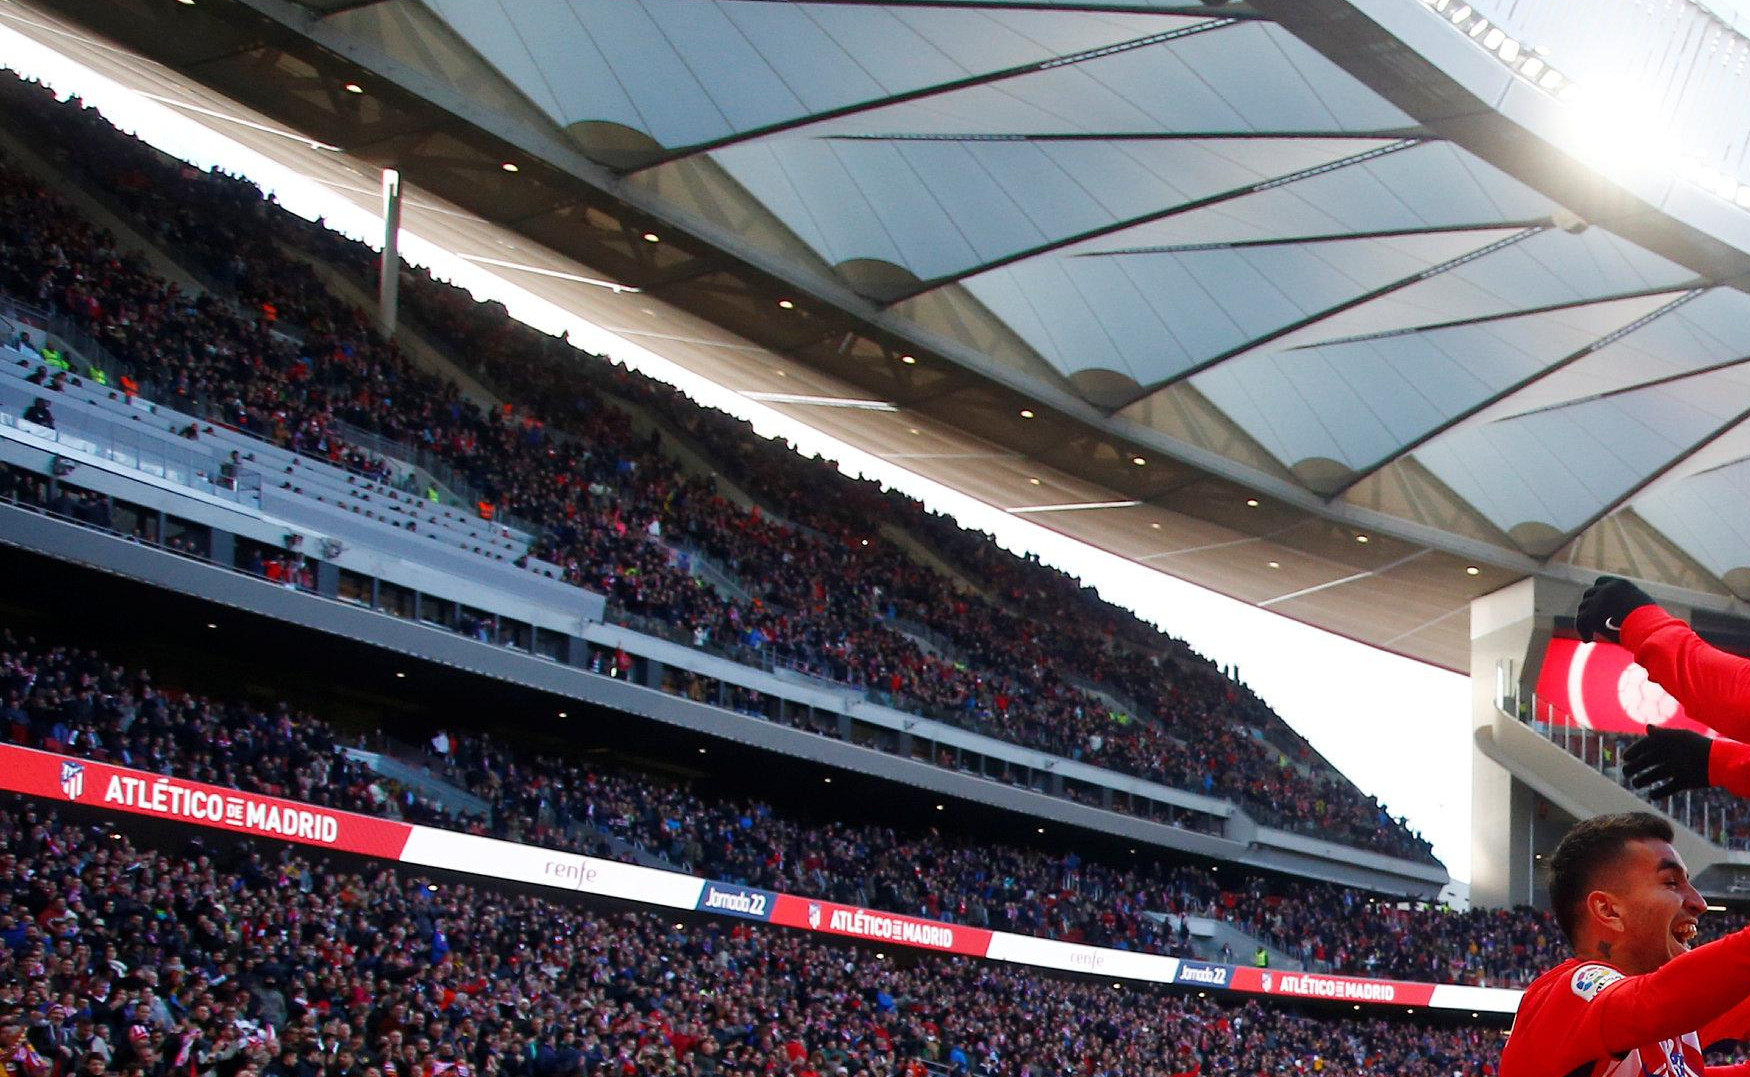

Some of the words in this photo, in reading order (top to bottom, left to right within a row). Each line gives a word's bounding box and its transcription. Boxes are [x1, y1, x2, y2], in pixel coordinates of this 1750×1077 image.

[104, 774, 224, 822] ATLÉTICO
[246, 800, 339, 843] MADRID
[545, 860, 598, 890] renfe
[705, 887, 751, 913] Jornada
[750, 892, 767, 916] 22
[829, 908, 893, 939] ATLÉTICO
[903, 922, 953, 949] MADRID
[1070, 949, 1105, 970] renfe
[1179, 964, 1213, 983] Jornada
[1212, 966, 1227, 985] 22
[1279, 974, 1335, 997] ATLÉTICO
[1345, 983, 1395, 1001] MADRID
